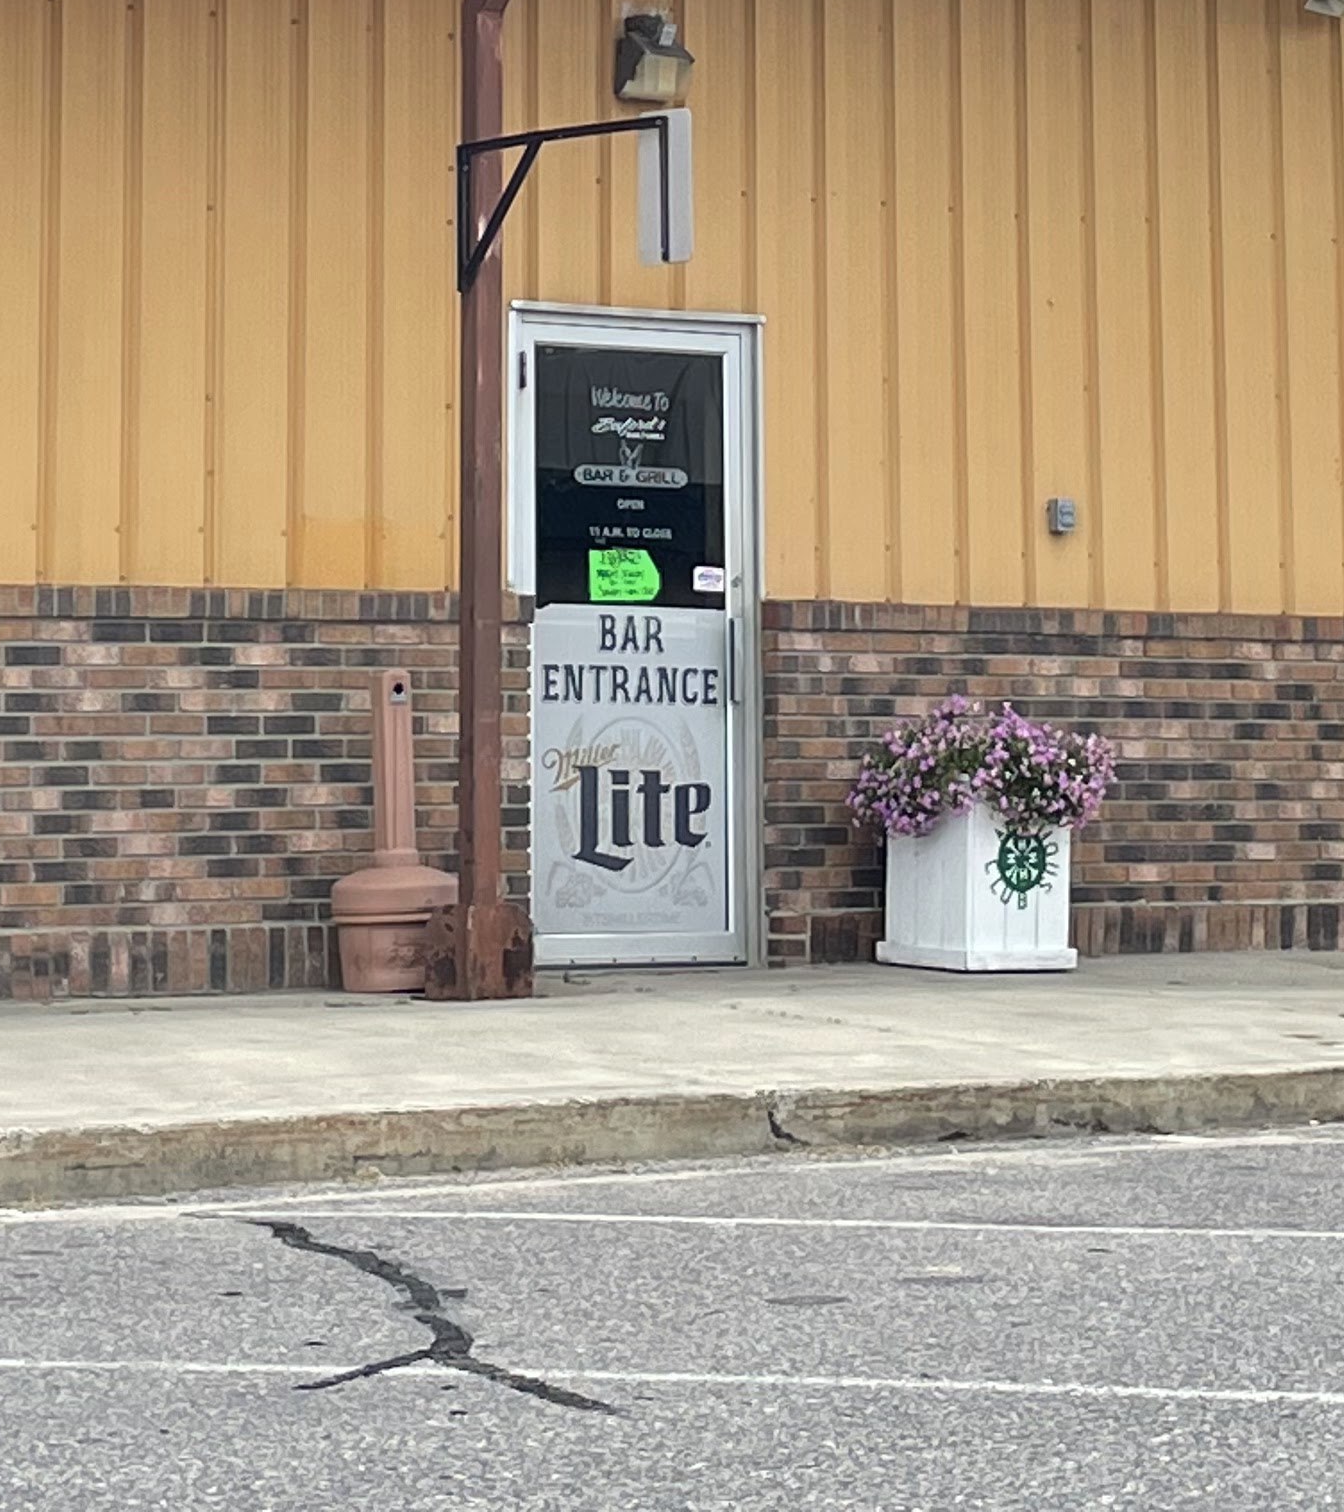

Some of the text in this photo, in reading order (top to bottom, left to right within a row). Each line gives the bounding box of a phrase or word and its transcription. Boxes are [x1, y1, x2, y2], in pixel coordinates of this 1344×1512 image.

[591, 386, 670, 412] Welcome To
[583, 468, 613, 481] BAR
[636, 471, 680, 485] GRILL
[599, 613, 664, 654] BAR
[542, 663, 719, 705] ENTRANCE
[542, 743, 620, 792] Miller
[571, 765, 712, 872] Lite
